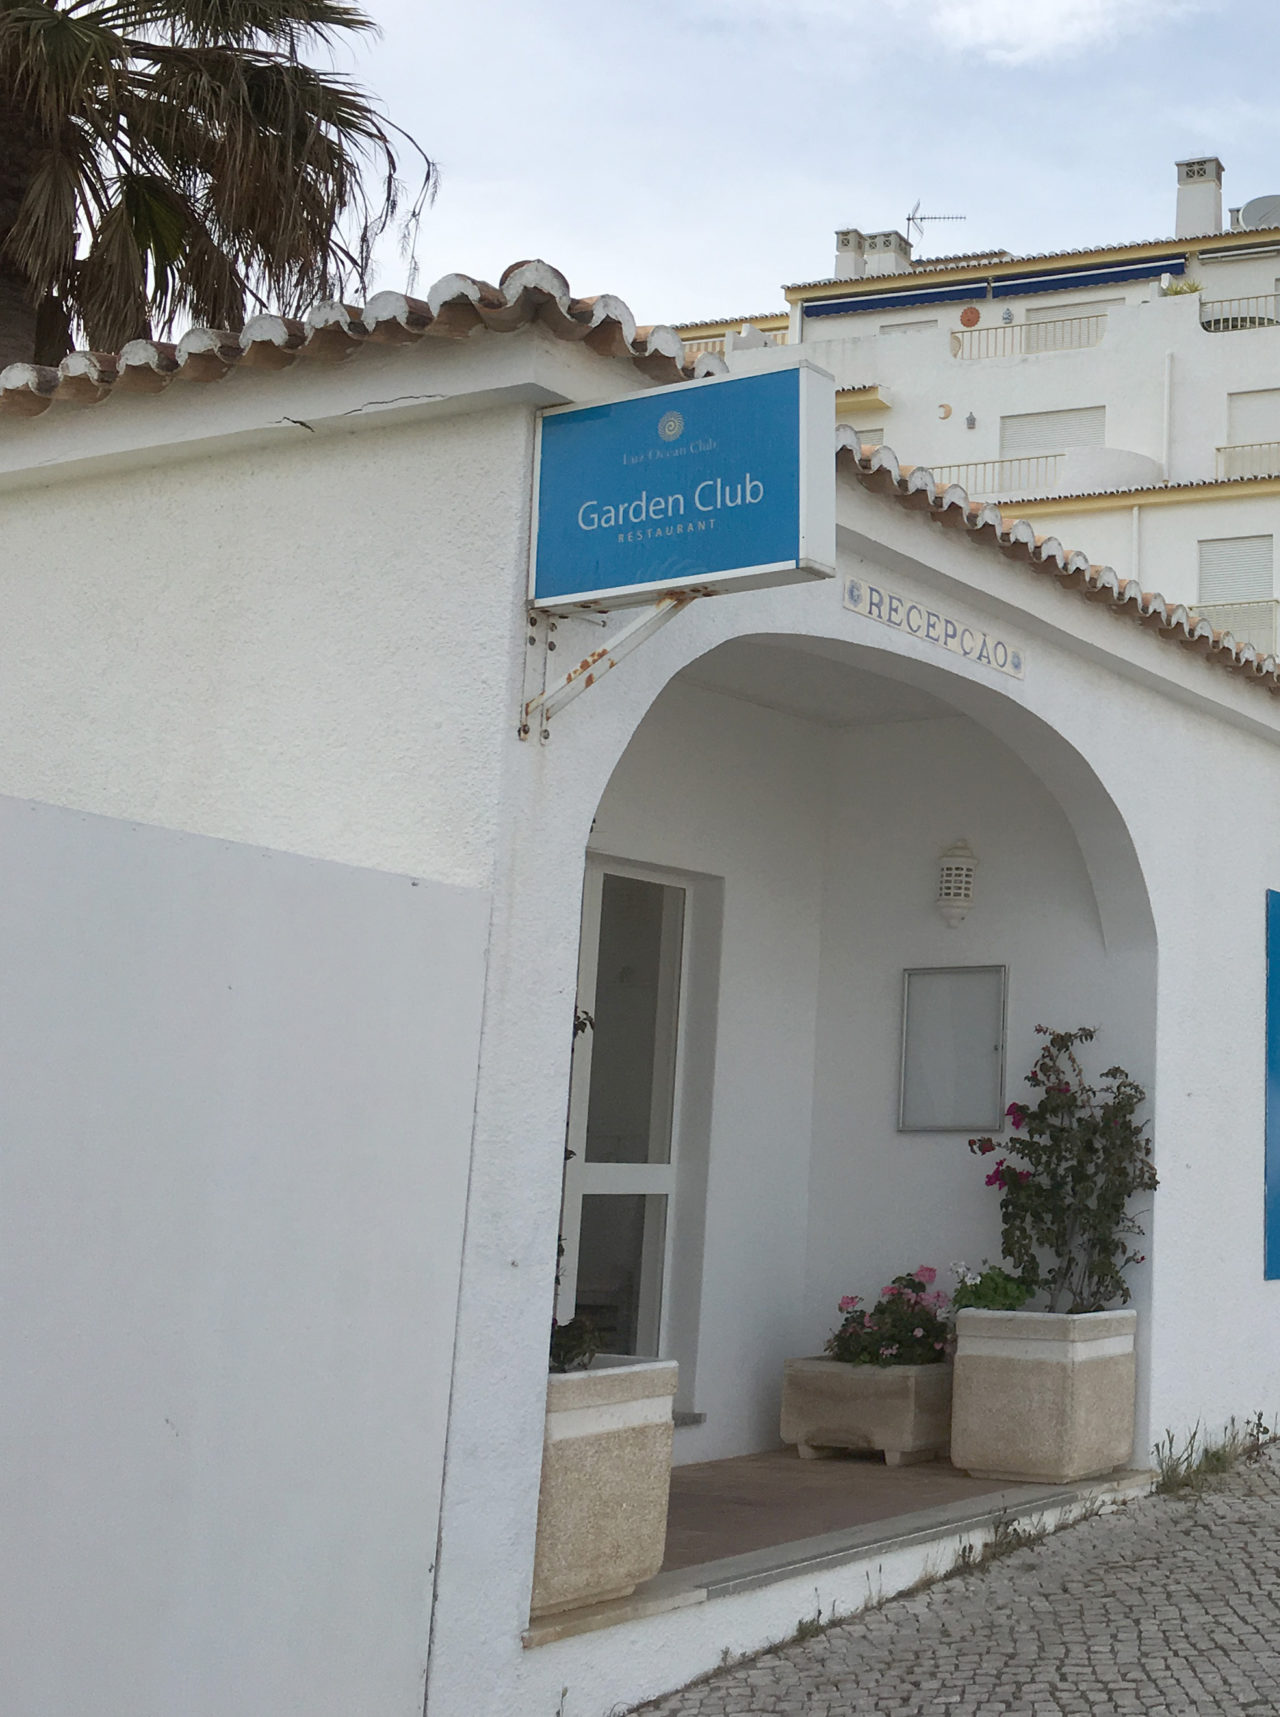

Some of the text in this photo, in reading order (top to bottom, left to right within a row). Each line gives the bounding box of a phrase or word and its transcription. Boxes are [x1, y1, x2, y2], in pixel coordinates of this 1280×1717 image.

[577, 473, 764, 531] Garden Club
[617, 518, 717, 543] RESTAURANT
[867, 586, 1008, 669] RECEPÇÃO
